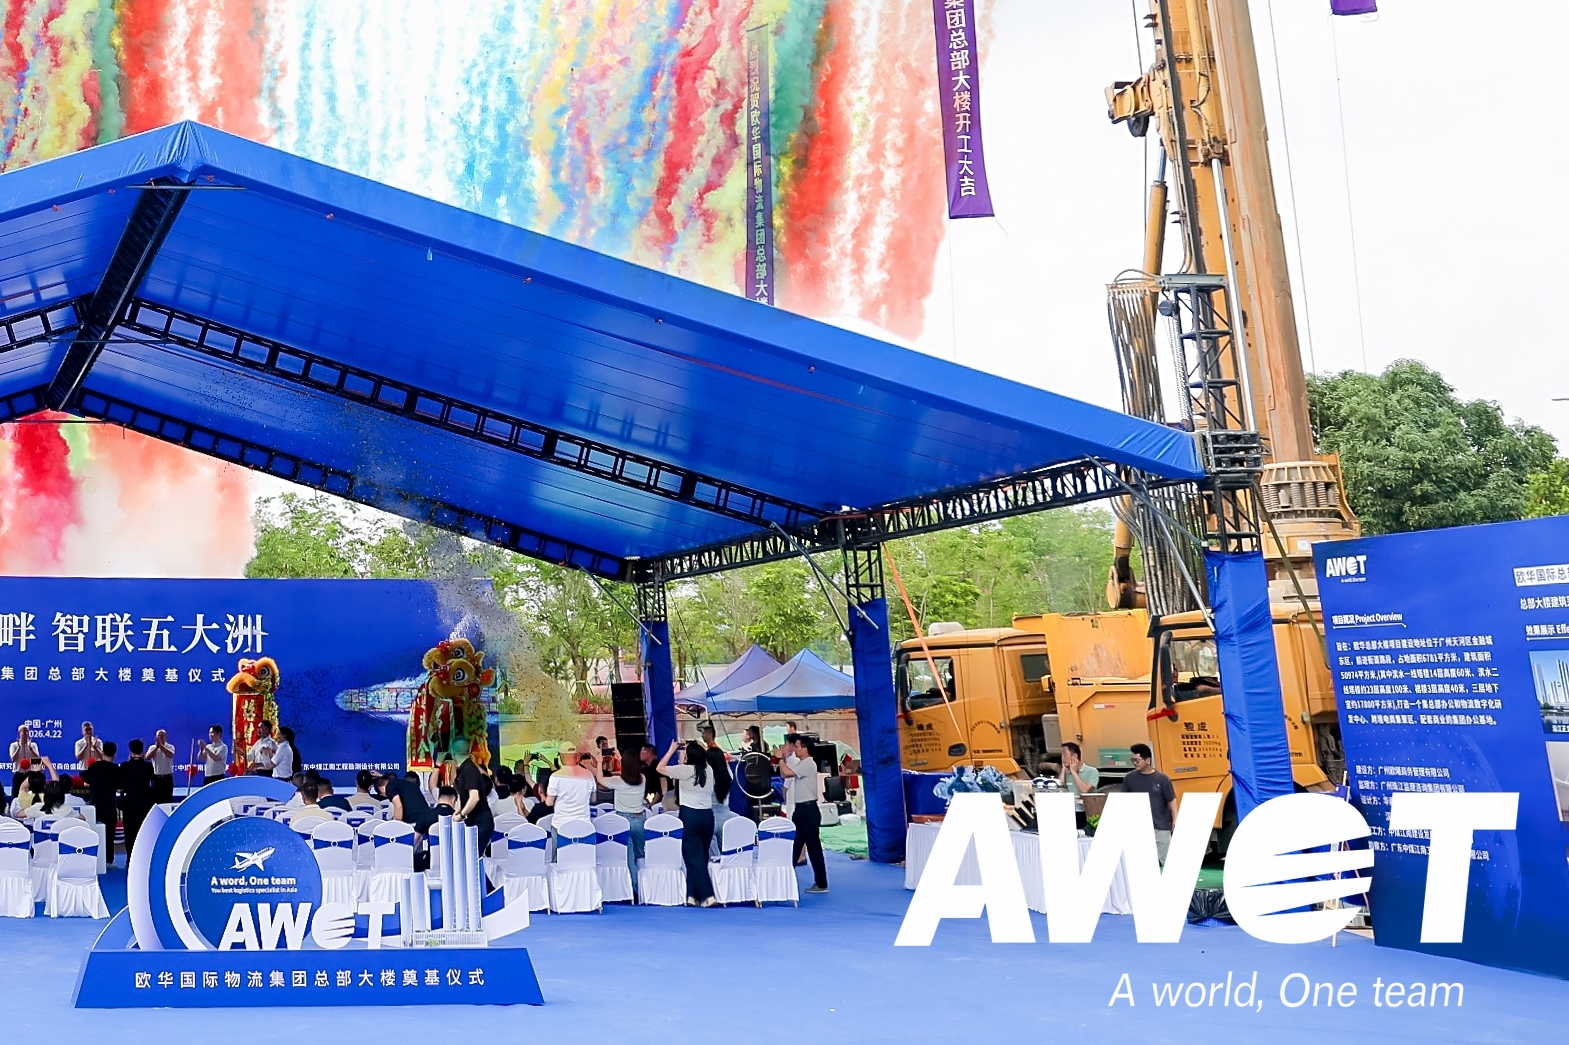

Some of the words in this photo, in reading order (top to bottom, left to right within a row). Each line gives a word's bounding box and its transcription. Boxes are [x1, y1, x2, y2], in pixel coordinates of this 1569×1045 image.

[1325, 555, 1367, 578] AWOT
[1355, 613, 1376, 625] Project
[1376, 611, 1403, 622] Overview
[51, 611, 264, 654] 智联五大洲
[1525, 624, 1555, 636] 效果展示
[28, 730, 62, 738] 026.4.22
[211, 876, 218, 886] A
[219, 875, 248, 887] word,
[249, 876, 269, 886] One
[270, 876, 296, 886] team
[234, 887, 255, 895] logistics
[256, 887, 280, 895] specialist
[218, 902, 396, 951] AWOT
[135, 968, 485, 988] 欧华国际物流集团总部大楼奠基仪式
